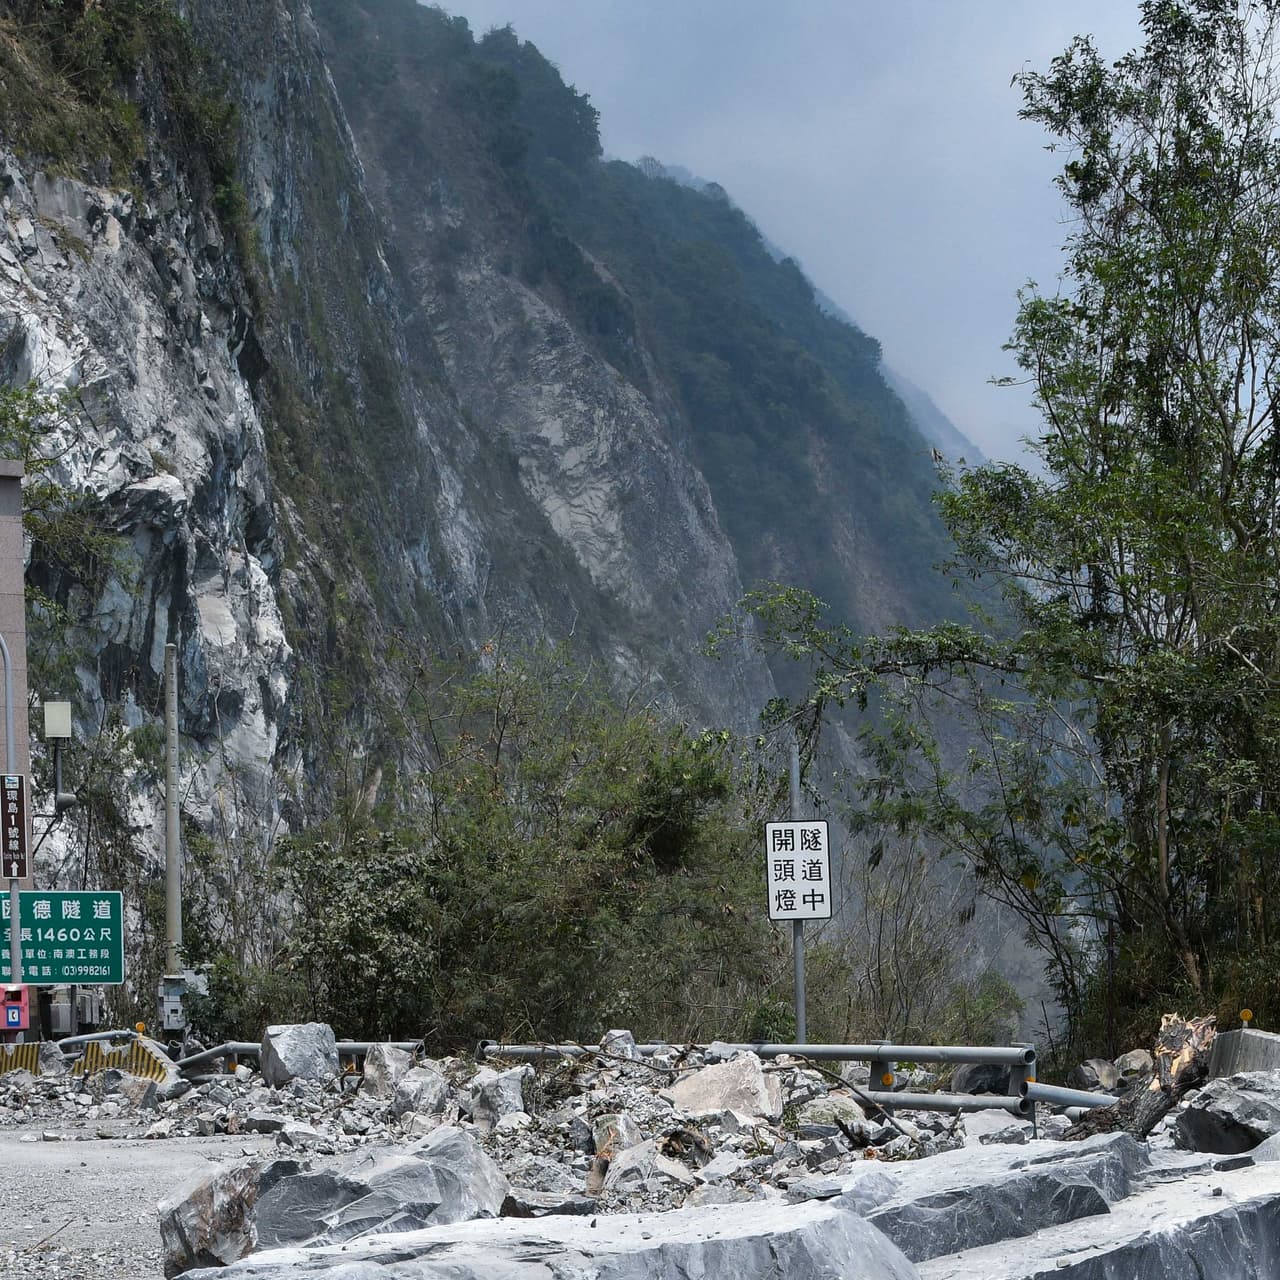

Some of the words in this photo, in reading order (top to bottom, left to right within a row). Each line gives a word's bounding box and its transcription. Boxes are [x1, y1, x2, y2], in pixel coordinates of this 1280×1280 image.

[772, 828, 797, 912] 開頭燈
[800, 828, 825, 912] 隧道中
